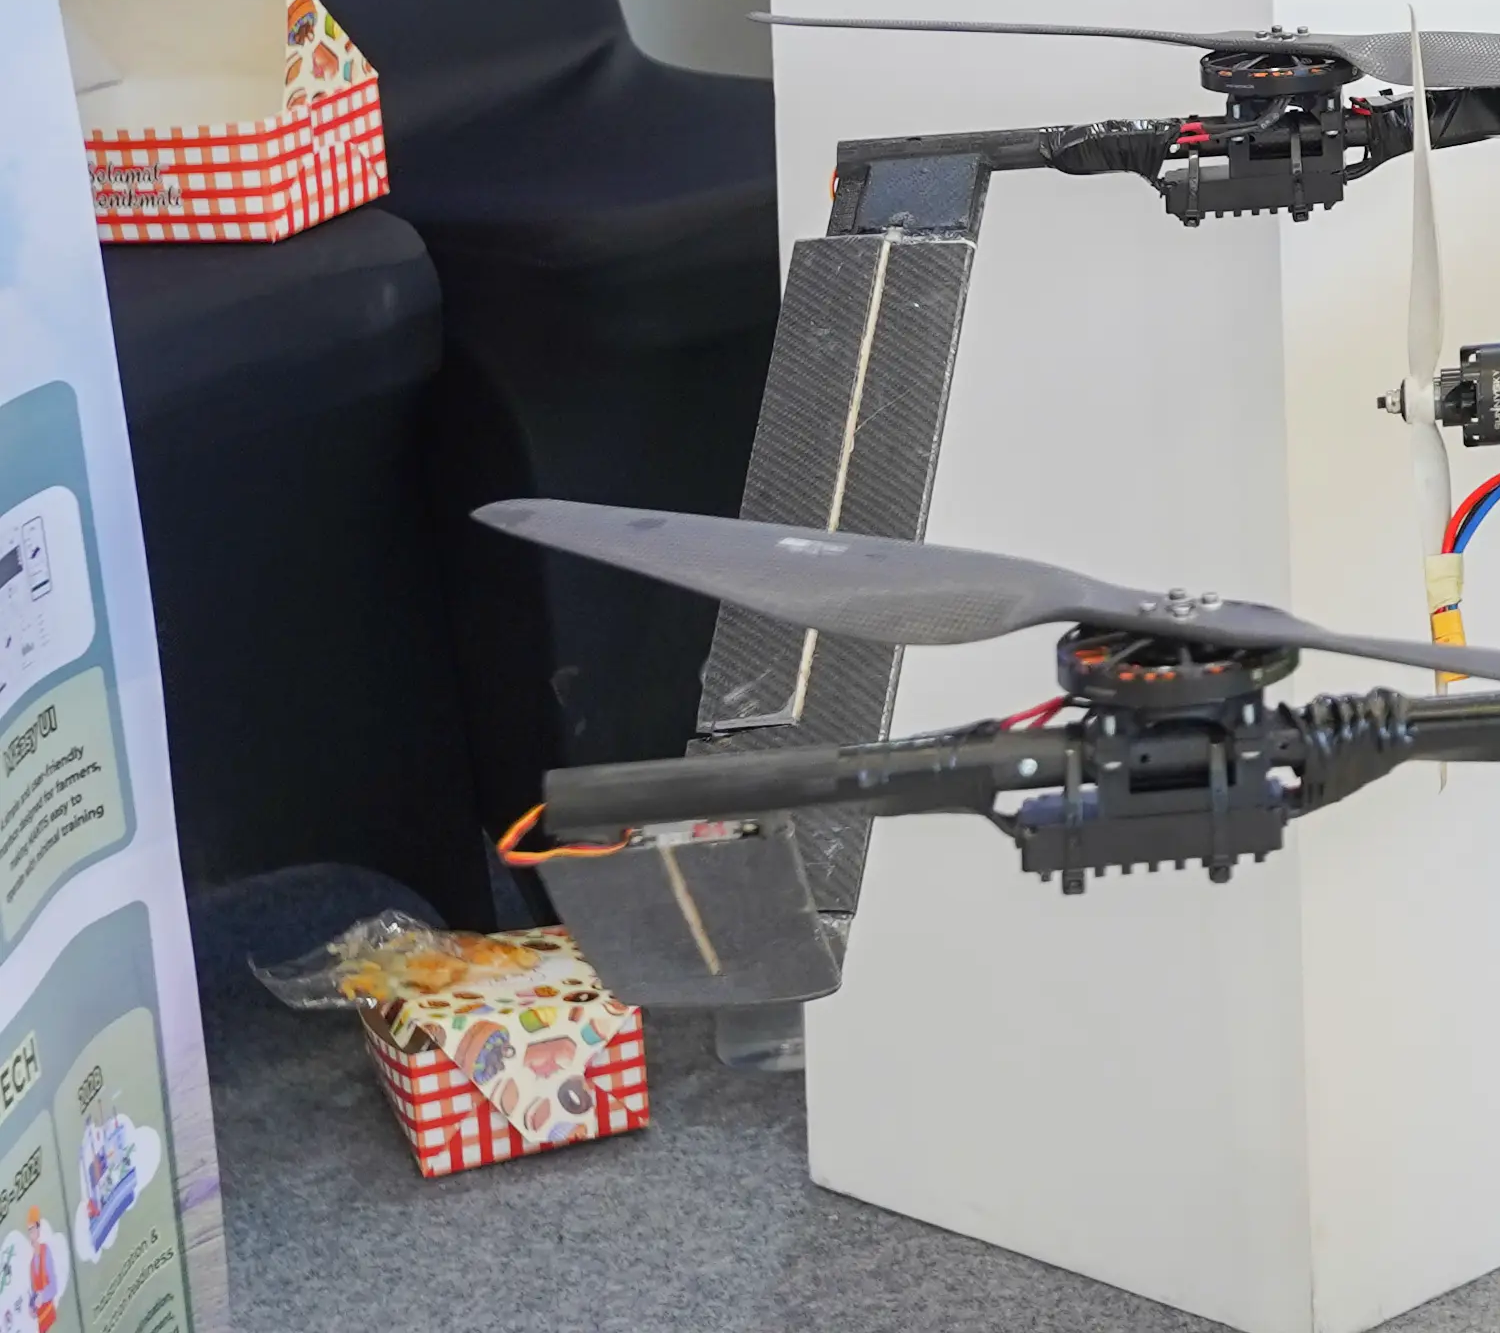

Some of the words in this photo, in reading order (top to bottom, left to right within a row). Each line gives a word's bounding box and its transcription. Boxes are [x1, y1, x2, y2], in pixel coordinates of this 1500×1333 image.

[98, 186, 183, 209] enikmati
[56, 761, 101, 793] farmers,
[50, 800, 68, 823] easy
[70, 792, 83, 808] to
[61, 803, 105, 837] training
[0, 1037, 39, 1107] ECH
